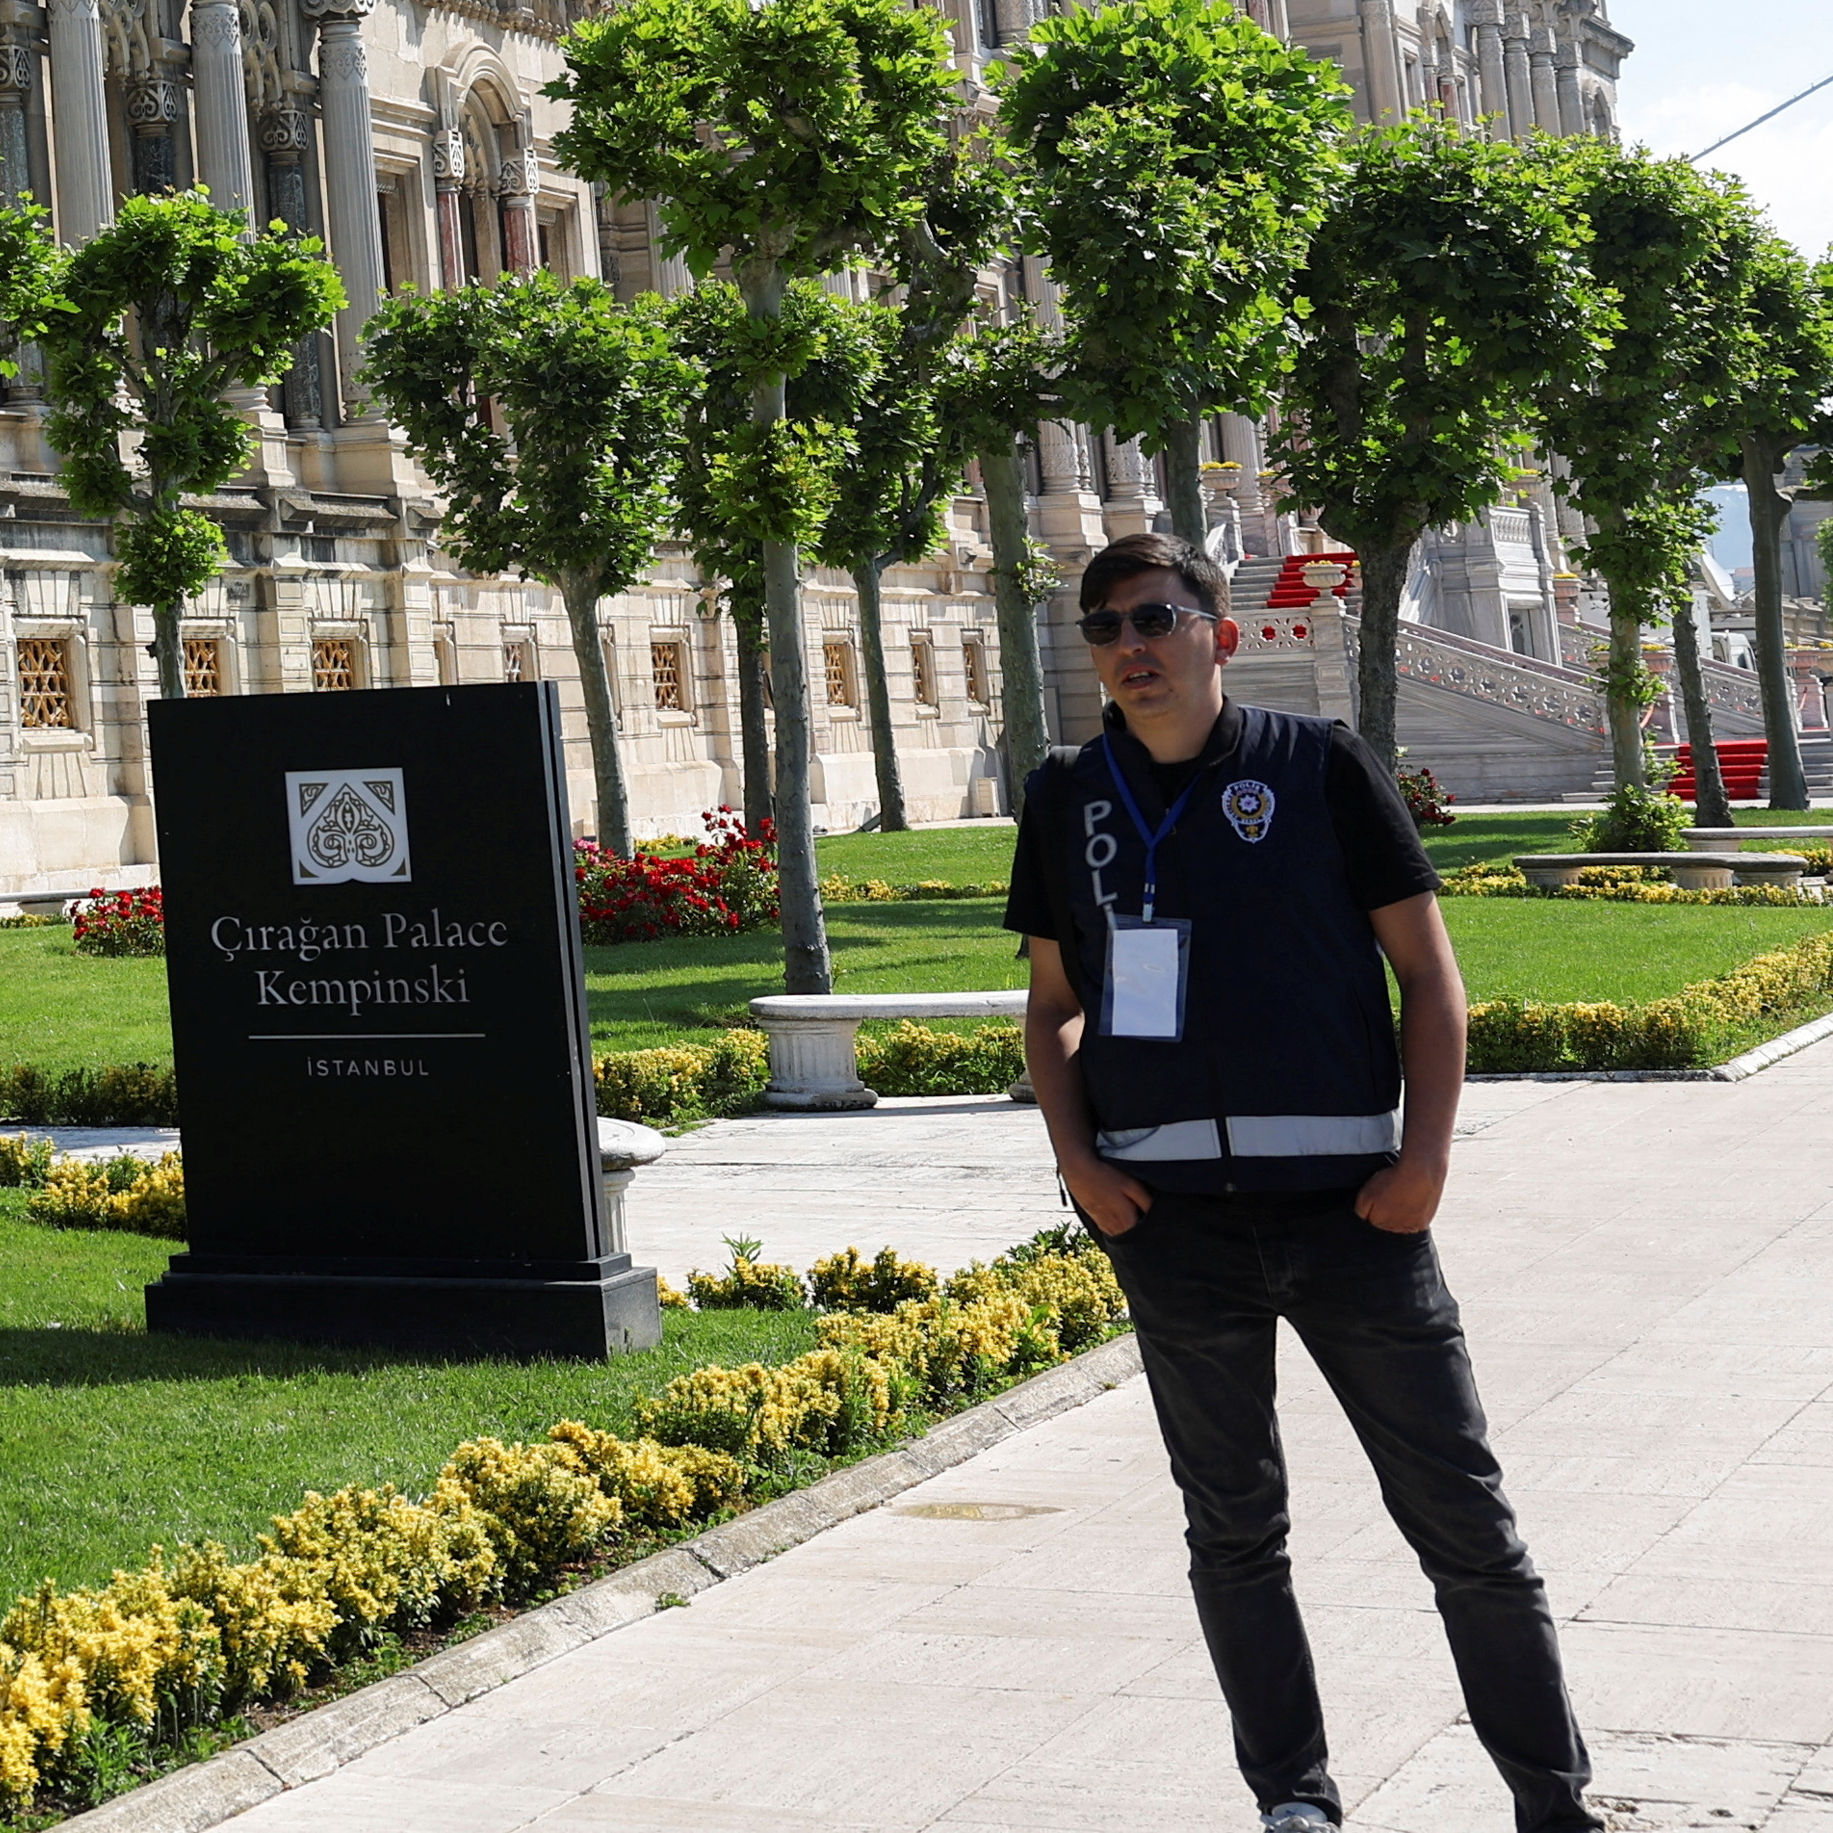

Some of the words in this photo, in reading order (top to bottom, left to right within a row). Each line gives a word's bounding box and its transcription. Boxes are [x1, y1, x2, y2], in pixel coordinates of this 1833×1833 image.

[1084, 800, 1118, 934] POLİ
[210, 915, 369, 962] Çırağan
[382, 907, 509, 948] Palace
[254, 963, 471, 1016] Kempinski
[307, 1056, 429, 1077] İSTANBUL
